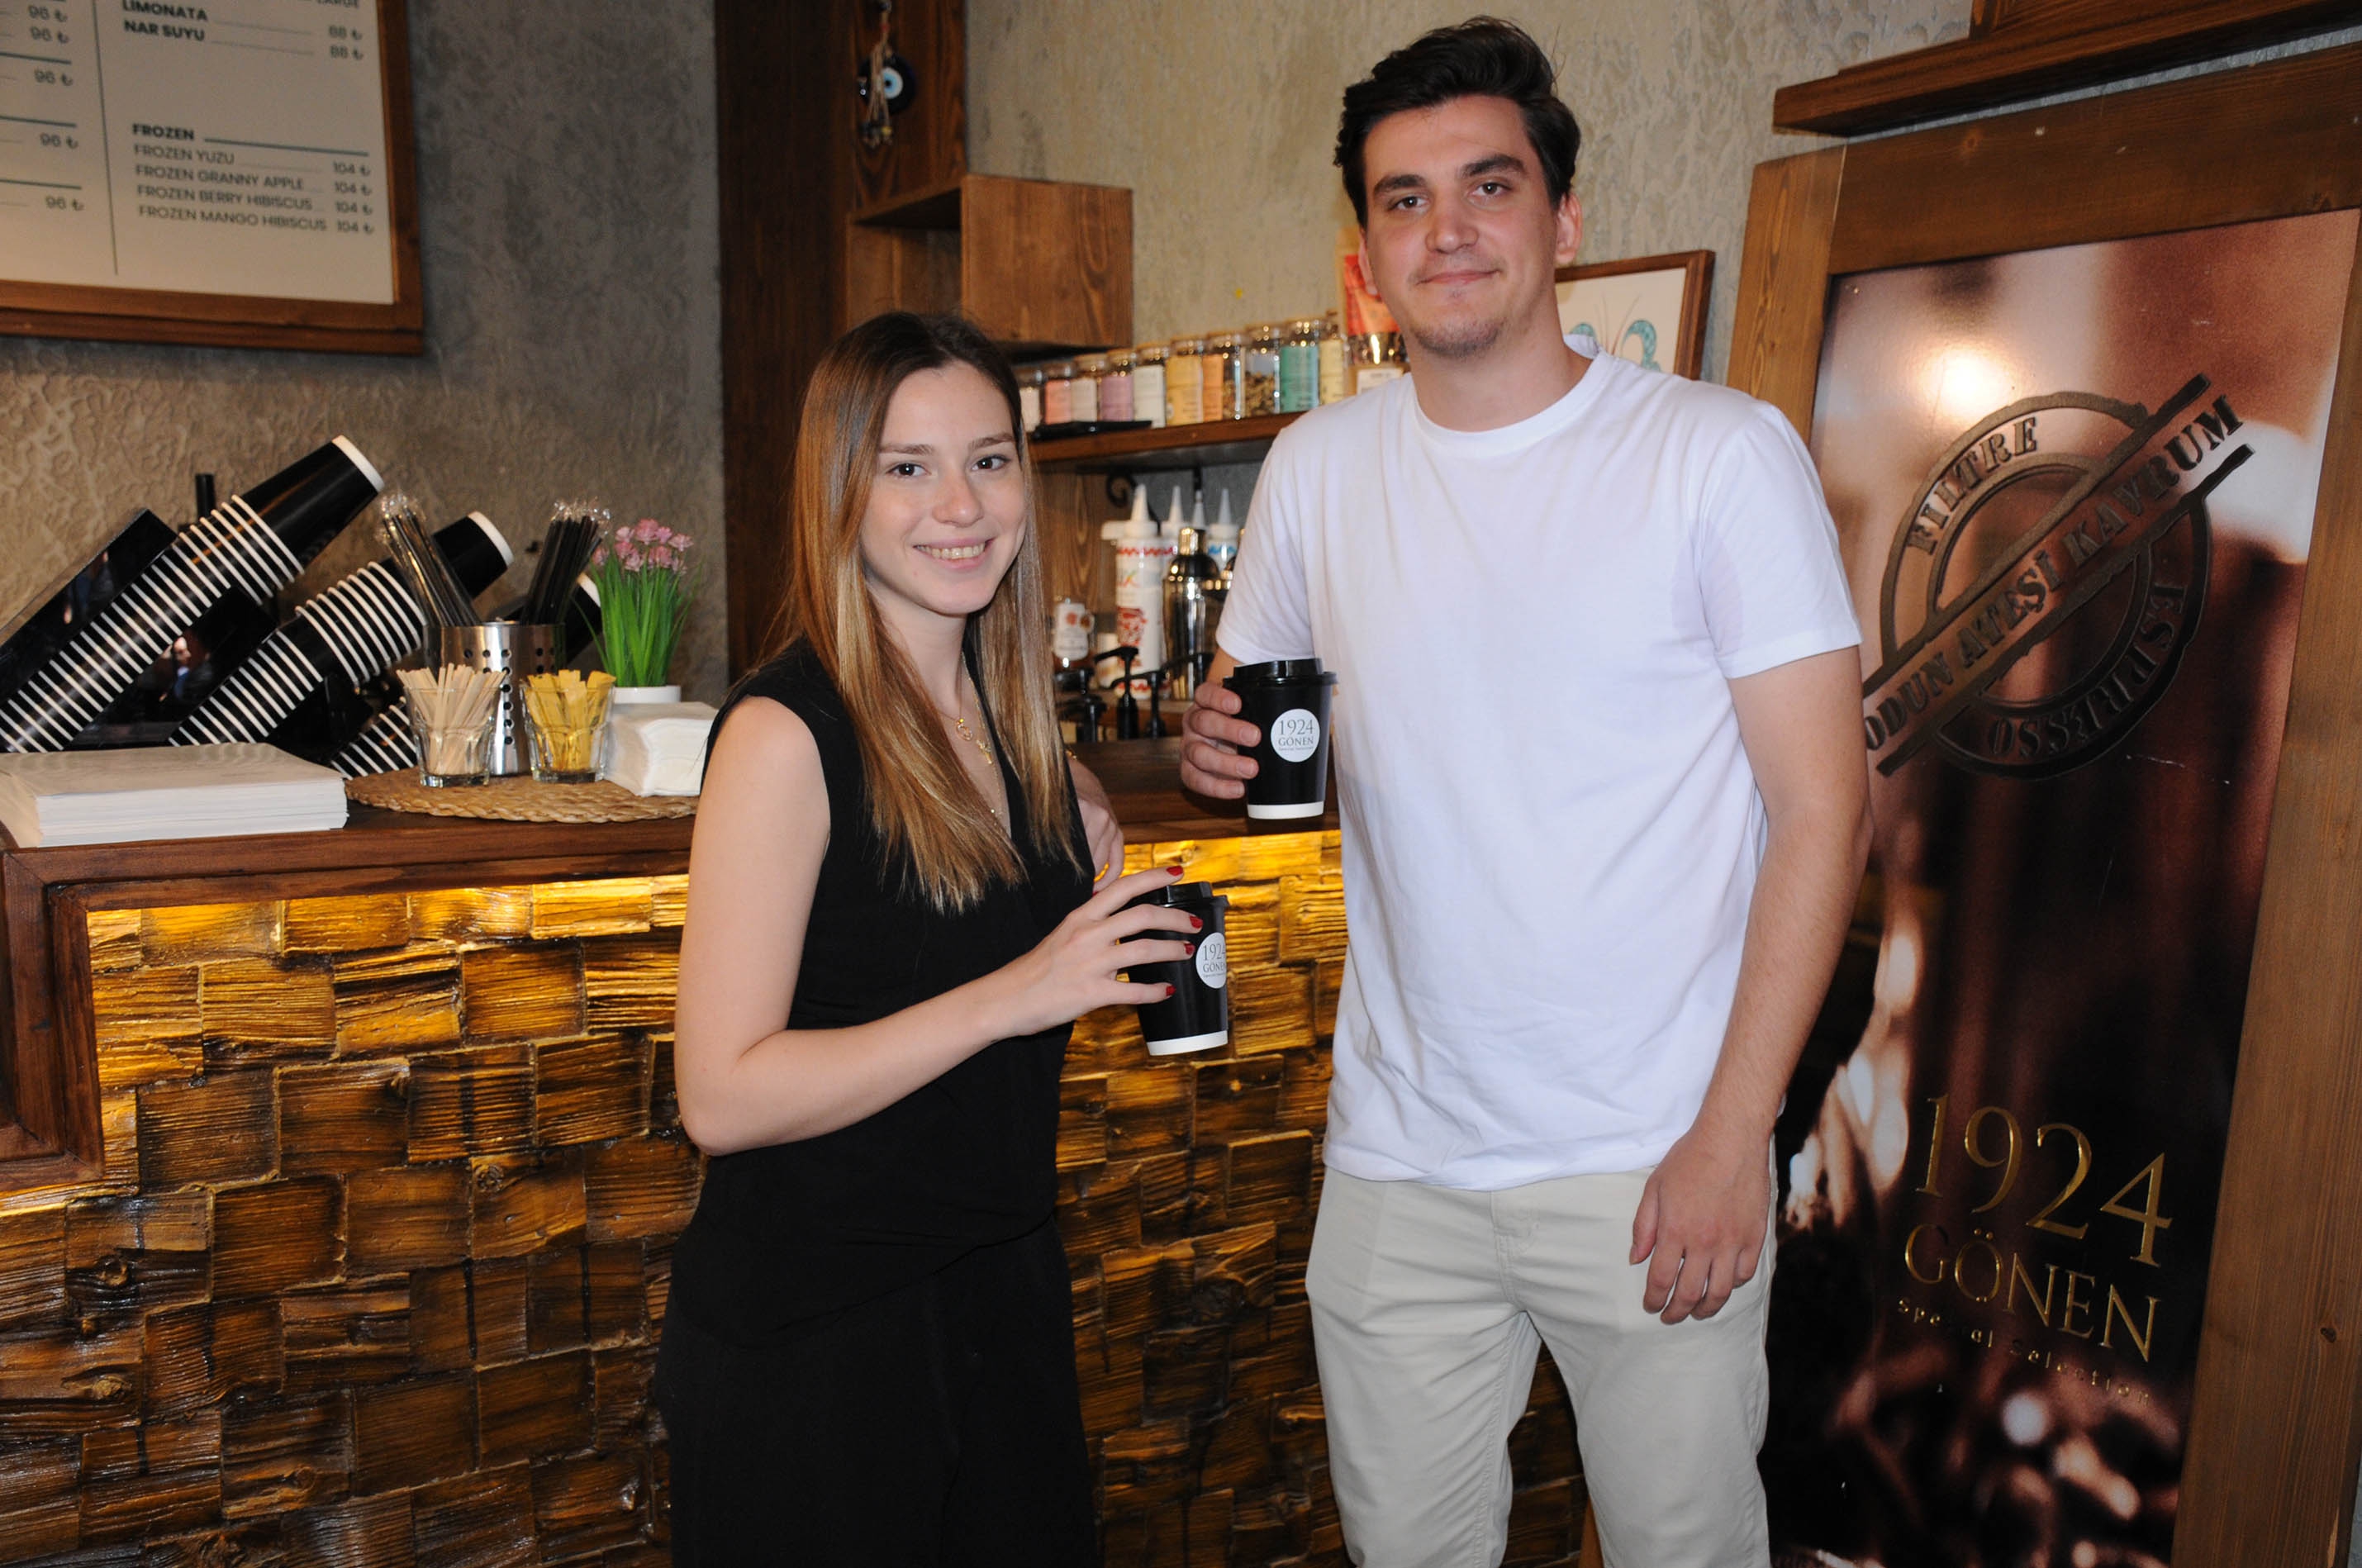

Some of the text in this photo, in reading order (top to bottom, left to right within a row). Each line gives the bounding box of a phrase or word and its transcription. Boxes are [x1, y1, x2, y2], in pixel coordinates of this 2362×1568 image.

[122, 0, 208, 21] LIMONATA
[123, 19, 159, 36] NAR
[162, 25, 205, 41] SUYU
[132, 123, 194, 141] FROZEN
[134, 143, 192, 160] FROZEN
[196, 150, 235, 165] YUZU
[333, 160, 356, 174] 104
[135, 164, 193, 181] FROZEN
[197, 169, 259, 186] GRANNY
[264, 175, 303, 191] APPLE
[335, 180, 357, 194] 104
[137, 183, 196, 202] FROZEN
[199, 189, 243, 204] BERRY
[247, 194, 313, 211] HIBISCUS
[335, 200, 358, 214] 104
[138, 204, 197, 221] FROZEN
[200, 210, 259, 226] MANGO
[262, 216, 327, 232] HIBISCUS
[336, 219, 359, 233] 104
[1905, 416, 2038, 556] FILTRE
[1864, 651, 1955, 752] ODUN
[2060, 394, 2244, 568] KAVRUM
[1988, 582, 2189, 758] ESPRESSO
[1280, 719, 1314, 735] 1924
[1915, 1094, 2173, 1268] 1924
[1903, 1223, 2161, 1363] GÖNEN
[1898, 1298, 1994, 1349] Speal
